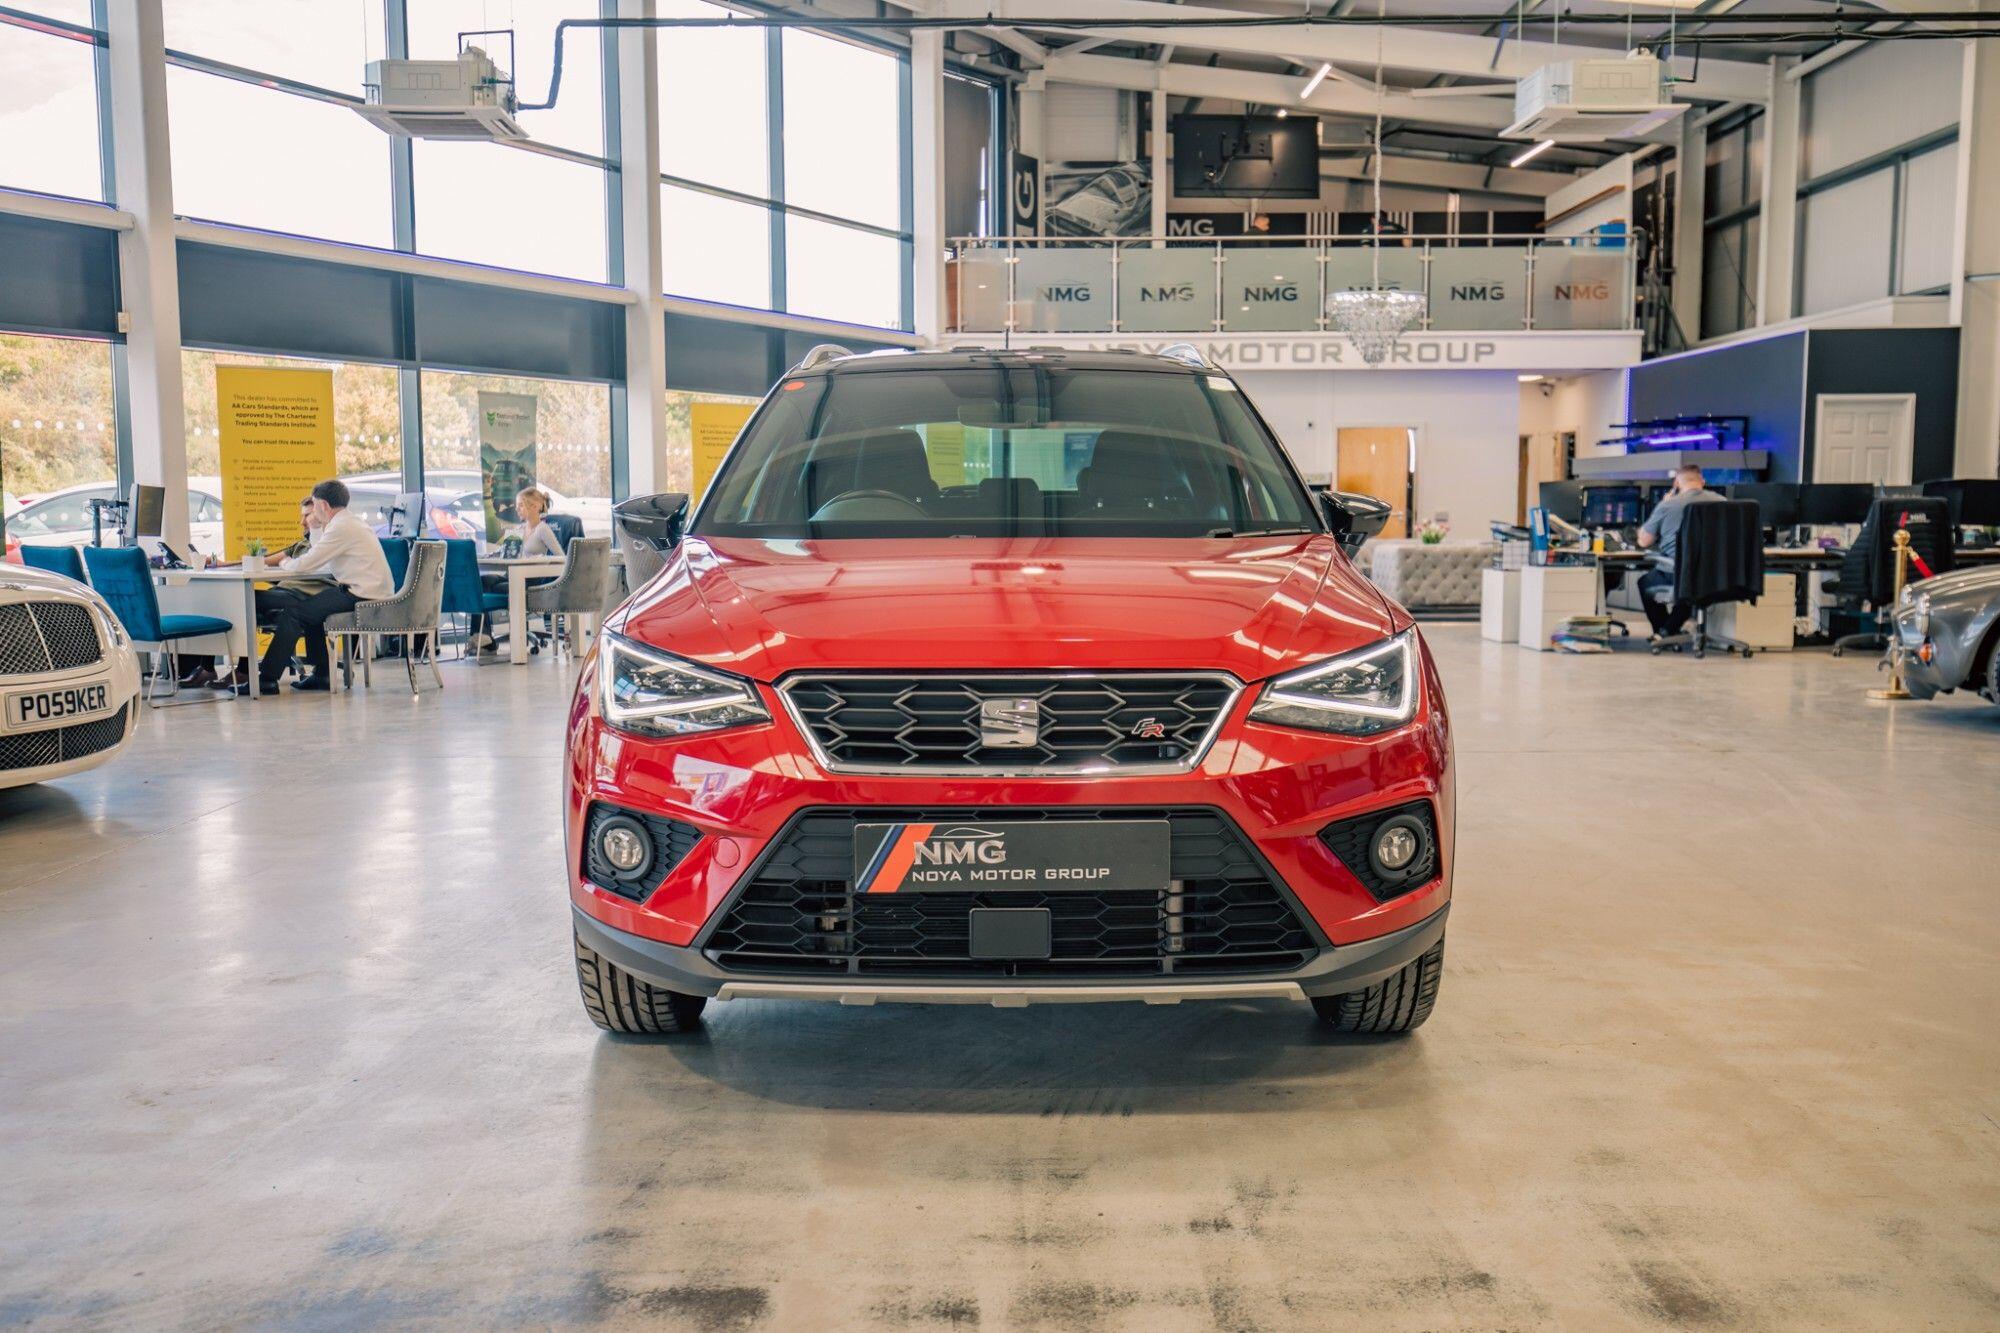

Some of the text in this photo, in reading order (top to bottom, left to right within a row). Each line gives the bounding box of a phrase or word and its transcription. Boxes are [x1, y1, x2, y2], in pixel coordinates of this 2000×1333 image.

[1036, 287, 1090, 301] NMG
[1141, 287, 1194, 301] NMG
[1244, 287, 1297, 301] NMG
[1451, 286, 1504, 300] NMG
[1555, 285, 1609, 300] NMG
[1208, 343, 1343, 363] MOTOR
[1367, 342, 1495, 363] ROUP
[20, 685, 106, 721] PO59KER
[1131, 717, 1165, 738] FR
[912, 840, 1007, 866] NMG
[912, 867, 1110, 882] NOYA MOTOR GROUP
